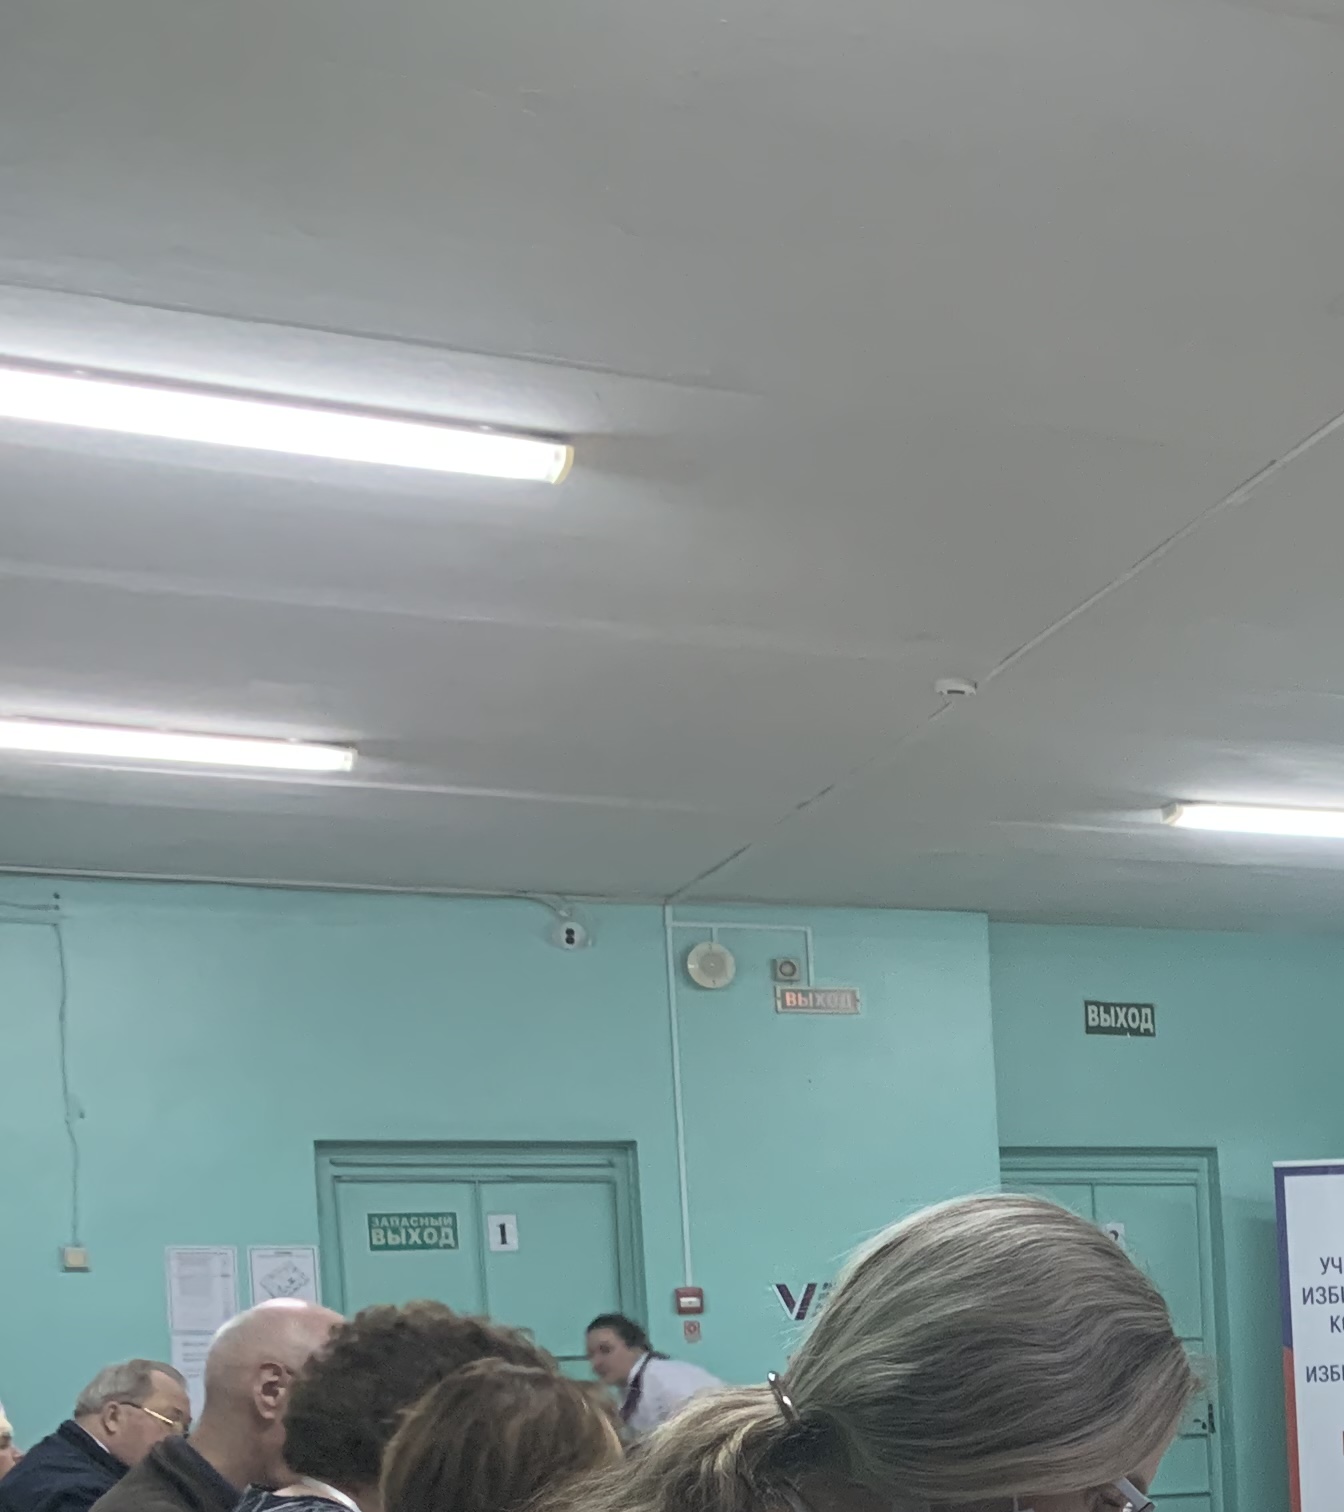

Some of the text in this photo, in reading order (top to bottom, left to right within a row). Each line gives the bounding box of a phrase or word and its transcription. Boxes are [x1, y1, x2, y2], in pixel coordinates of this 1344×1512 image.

[785, 991, 852, 1008] ВЫХОД
[1087, 1004, 1154, 1034] ВЫХОД
[371, 1215, 453, 1228] ЗАПАСНЫЙ
[371, 1227, 456, 1249] ВЫХОД
[496, 1223, 509, 1245] 1
